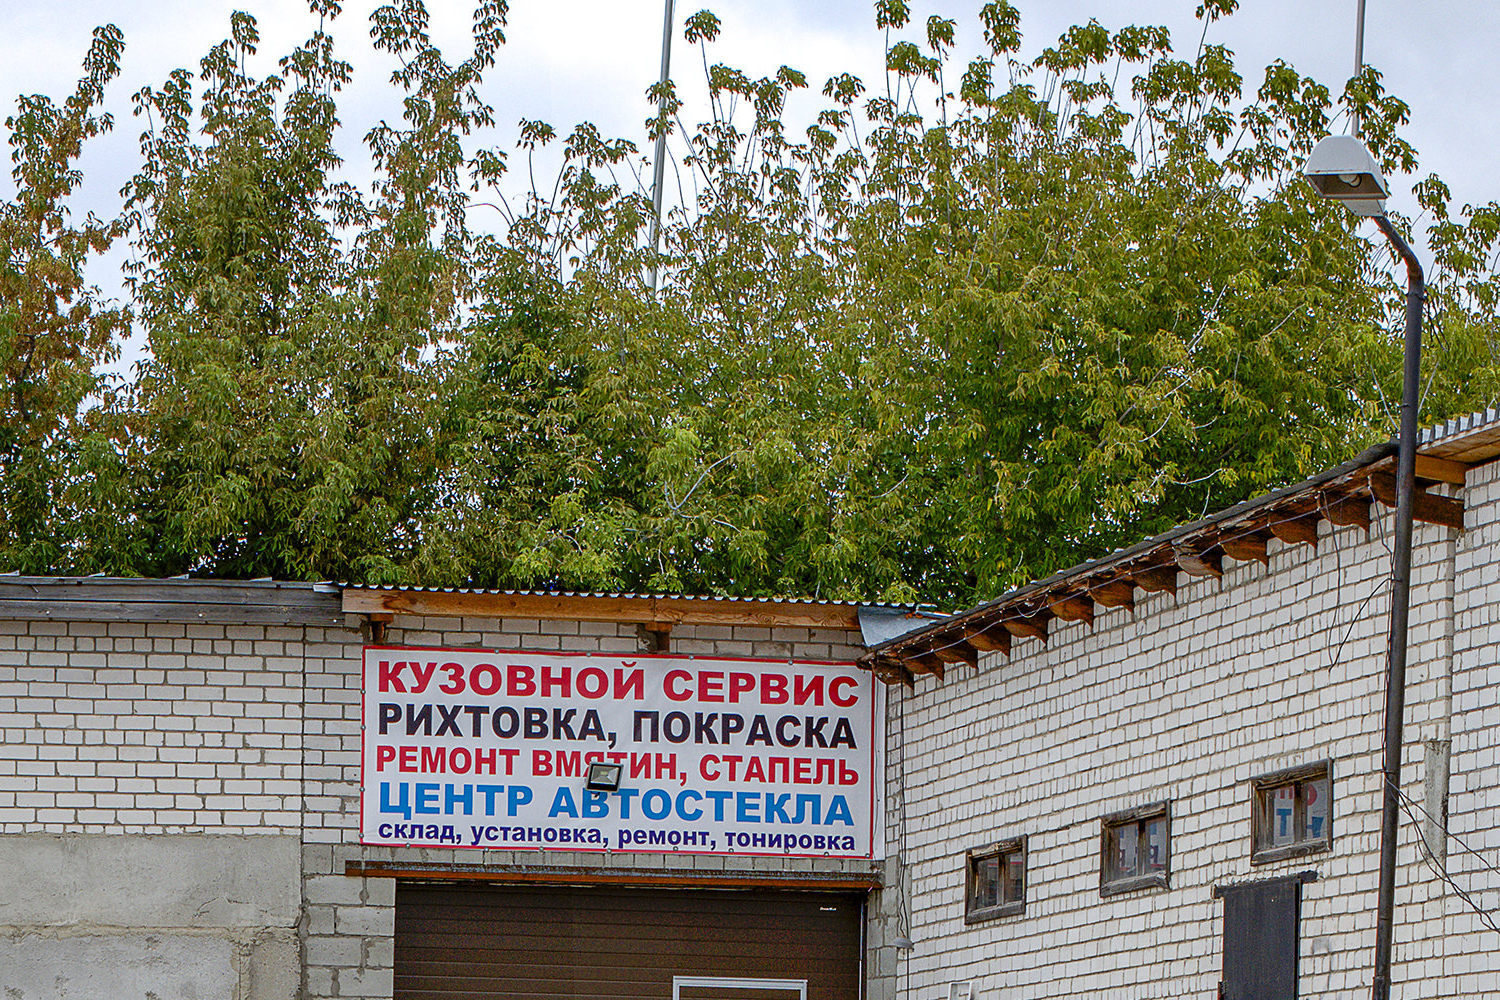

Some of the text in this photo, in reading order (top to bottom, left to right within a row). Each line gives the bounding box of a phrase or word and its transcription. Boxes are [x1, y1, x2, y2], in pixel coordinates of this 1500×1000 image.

[378, 660, 859, 708] КУЗОВНОЙ СЕРВИС
[378, 702, 857, 750] РИХТОВКА, ПОКРАСКА
[376, 745, 520, 776] РЕМОНТ
[699, 753, 860, 786] СТАПЕЛЬ
[379, 782, 855, 826] ЦЕНТР АВТОСТЕКЛА
[378, 823, 856, 851] склад, установка, ремонт, тонировка
